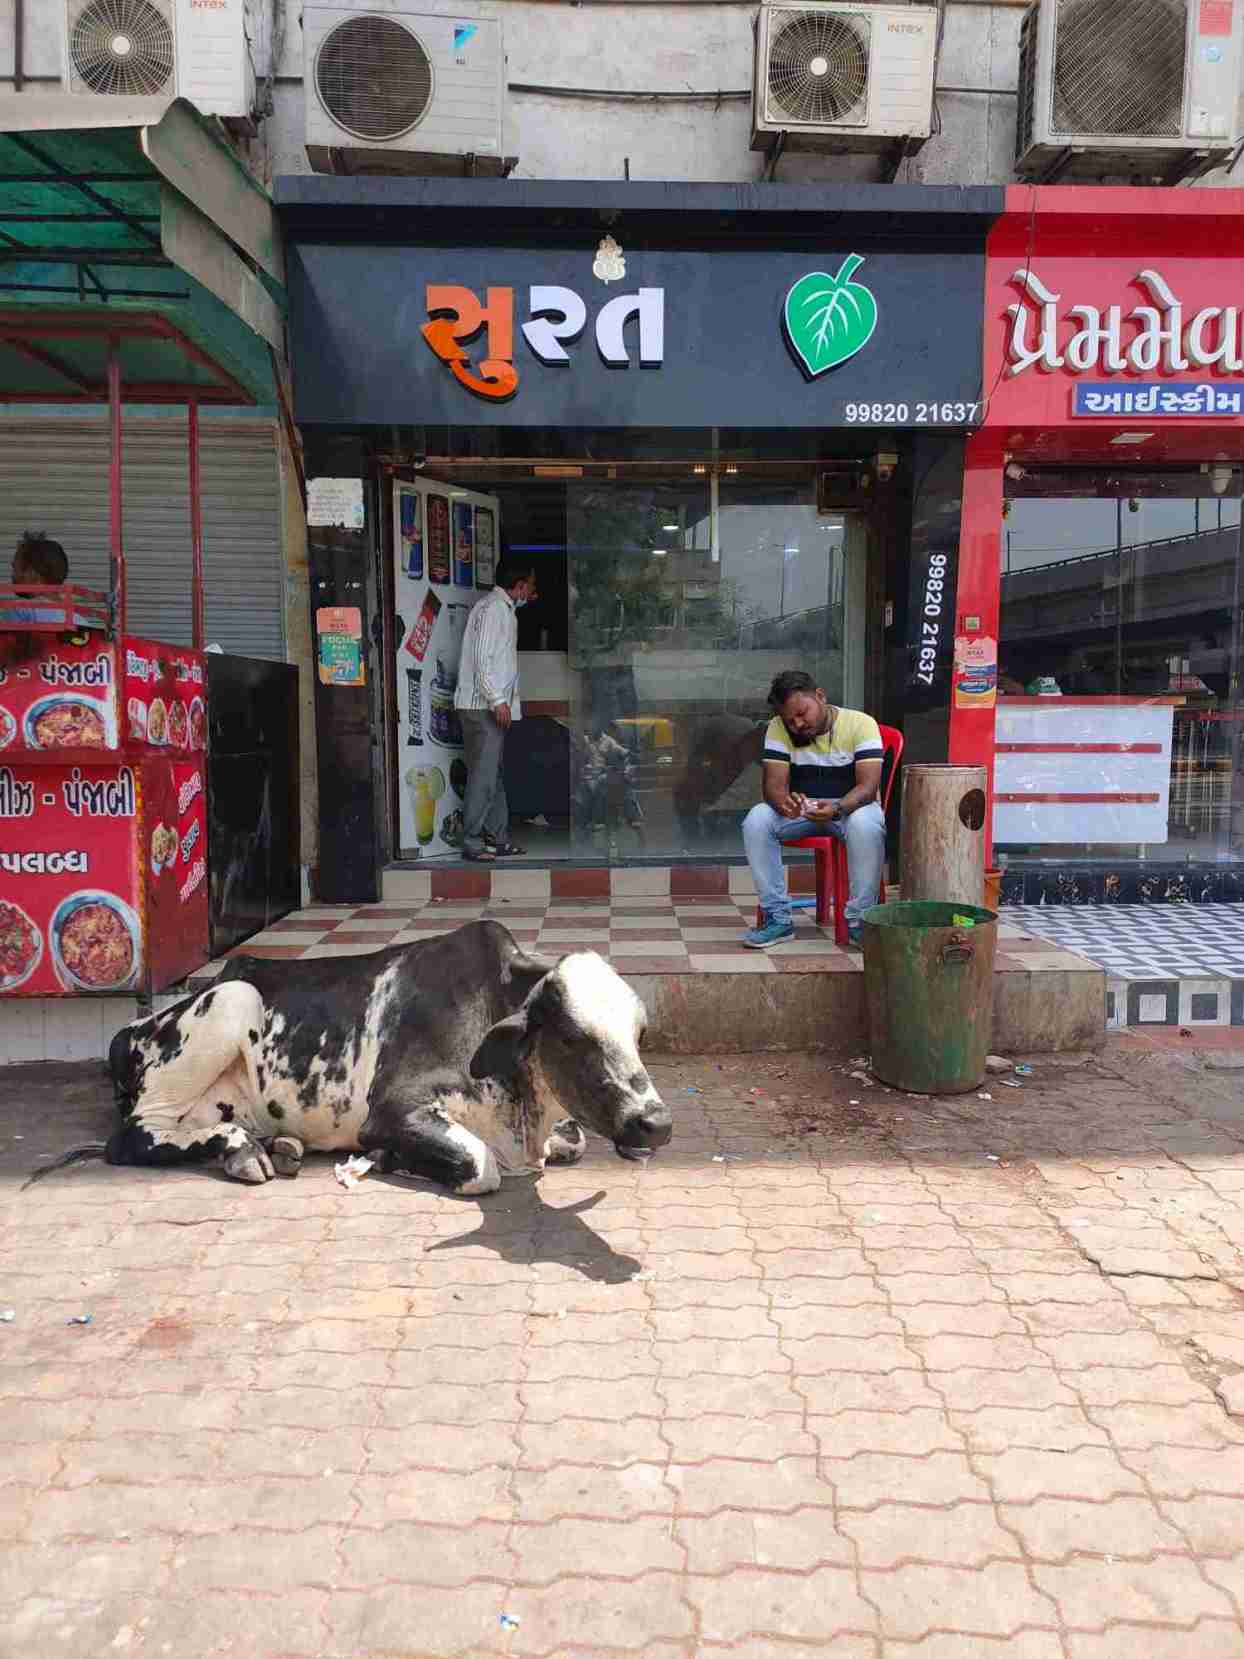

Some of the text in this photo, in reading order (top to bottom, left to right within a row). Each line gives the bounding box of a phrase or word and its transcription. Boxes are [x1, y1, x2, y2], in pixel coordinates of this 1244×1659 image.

[420, 285, 664, 404] સુરત
[1006, 269, 1244, 374] પ્રેમમેવ
[845, 403, 978, 422] 99820 21637
[917, 554, 946, 685] 99820 21637
[62, 766, 136, 816] પંજાબી
[0, 850, 88, 873] પલબ્ધ
